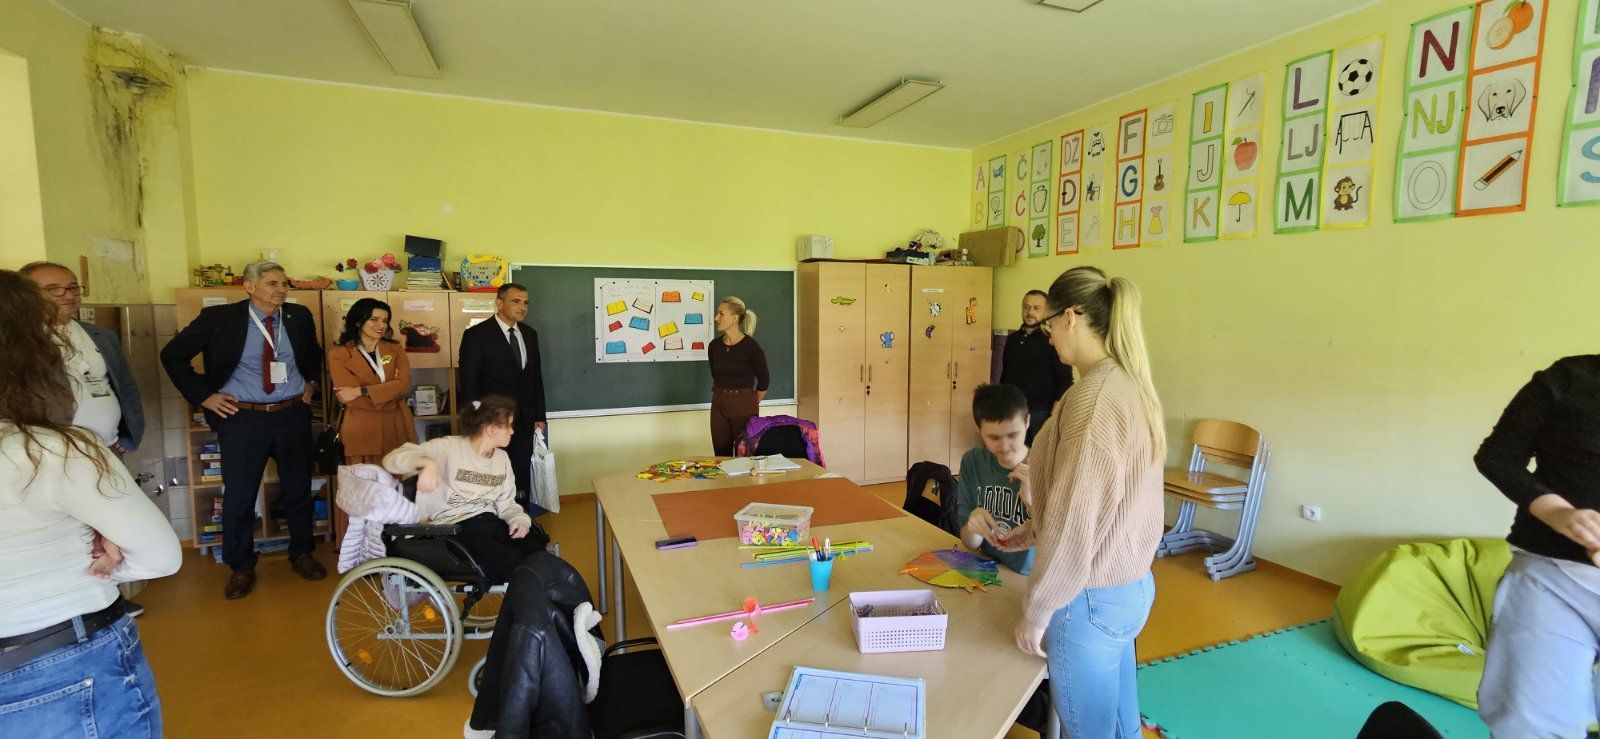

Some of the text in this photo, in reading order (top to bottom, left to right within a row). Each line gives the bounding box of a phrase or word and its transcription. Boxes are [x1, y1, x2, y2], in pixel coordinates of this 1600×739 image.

[1419, 21, 1460, 78] N
[1292, 67, 1319, 110] L
[1202, 101, 1214, 134] I
[1412, 90, 1456, 139] NJ
[1123, 117, 1142, 154] F
[1287, 123, 1319, 161] LJ
[975, 165, 986, 191] A
[1017, 154, 1028, 181] Č
[1196, 144, 1215, 182] J
[1121, 164, 1138, 197] G
[1408, 160, 1447, 210] O
[974, 202, 985, 225] B
[1015, 190, 1026, 217] Ć
[1192, 196, 1211, 230] K
[1285, 178, 1313, 222] M
[1060, 217, 1075, 247] E
[1119, 206, 1137, 240] H
